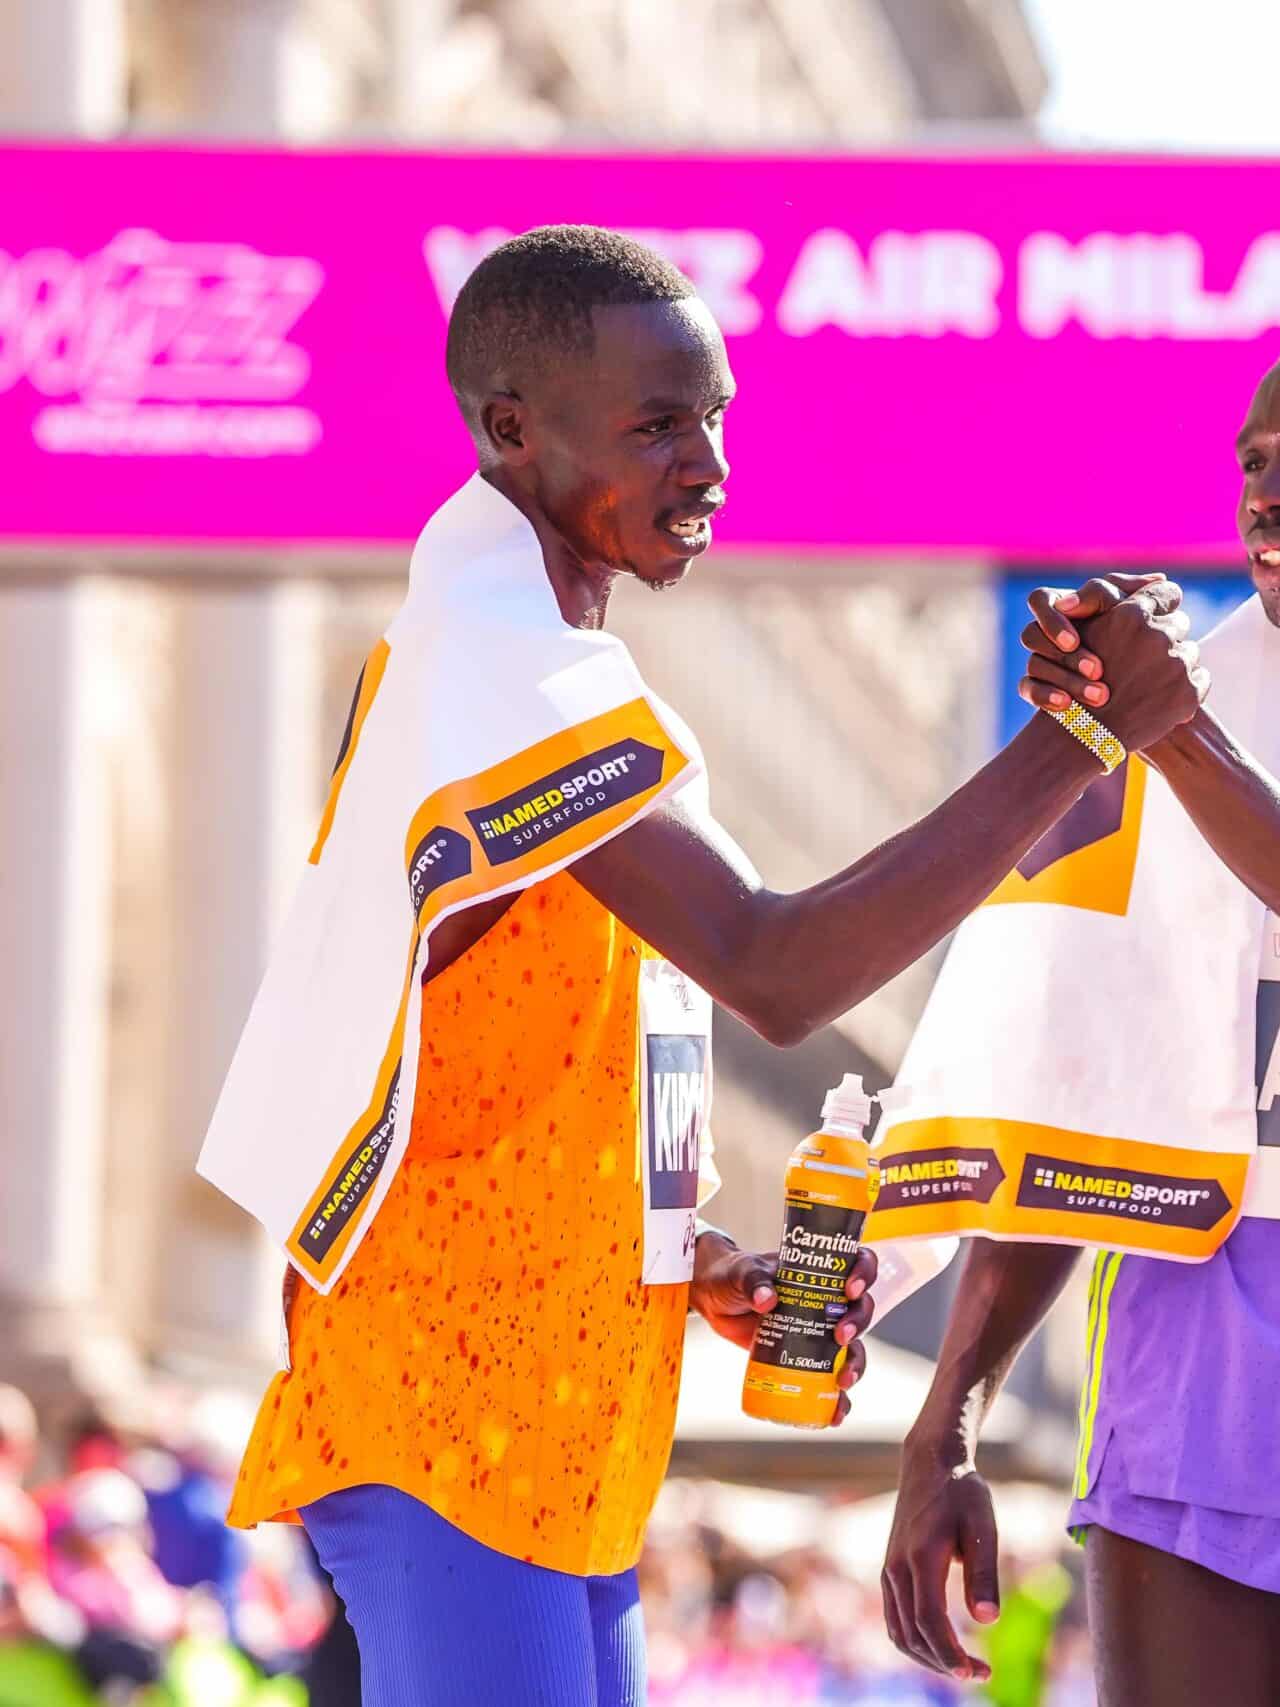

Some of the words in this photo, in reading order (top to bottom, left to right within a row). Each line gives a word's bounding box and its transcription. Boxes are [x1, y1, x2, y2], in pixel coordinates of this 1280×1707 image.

[777, 228, 1002, 338] AIR
[512, 790, 607, 846] SUPERFOOD
[1065, 1194, 1164, 1217] SUPERFOOD
